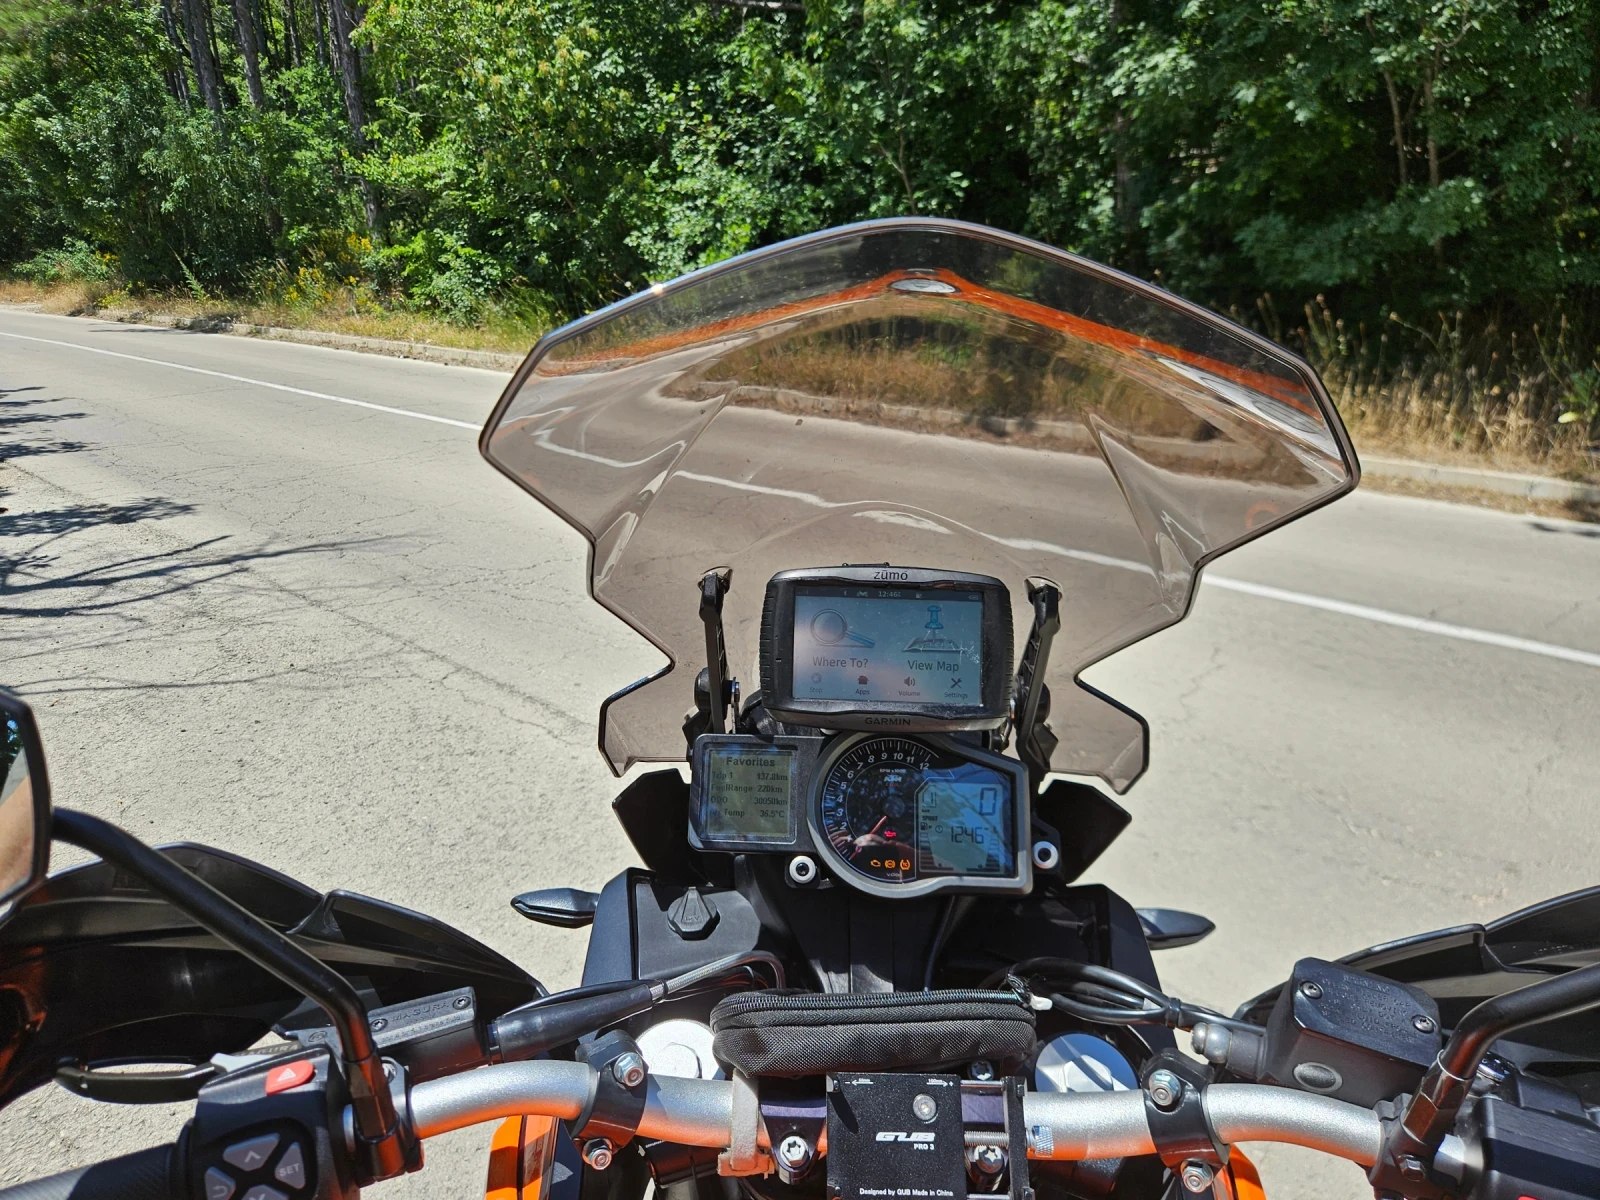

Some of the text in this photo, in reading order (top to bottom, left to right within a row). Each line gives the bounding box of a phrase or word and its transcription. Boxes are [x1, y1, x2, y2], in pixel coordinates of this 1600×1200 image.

[813, 657, 869, 668] Where To?
[907, 660, 959, 673] View Map
[809, 686, 823, 694] Stop
[944, 692, 968, 700] Settings
[865, 717, 911, 726] GARMIN
[868, 755, 875, 763] 8
[881, 752, 888, 760] 9
[893, 752, 903, 760] 10
[906, 756, 915, 764] 11
[726, 757, 776, 767] Favorites
[857, 762, 863, 770] 7
[919, 762, 930, 770] 12
[847, 770, 854, 779] 6
[840, 782, 847, 790] 5
[836, 794, 843, 803] 4
[836, 808, 844, 817] 3
[840, 822, 847, 830] 2
[876, 1132, 936, 1142] GUB
[279, 1163, 300, 1177] SET
[860, 1188, 886, 1196] Designed
[888, 1188, 895, 1196] by
[912, 1188, 928, 1196] Made
[936, 1189, 954, 1197] China
